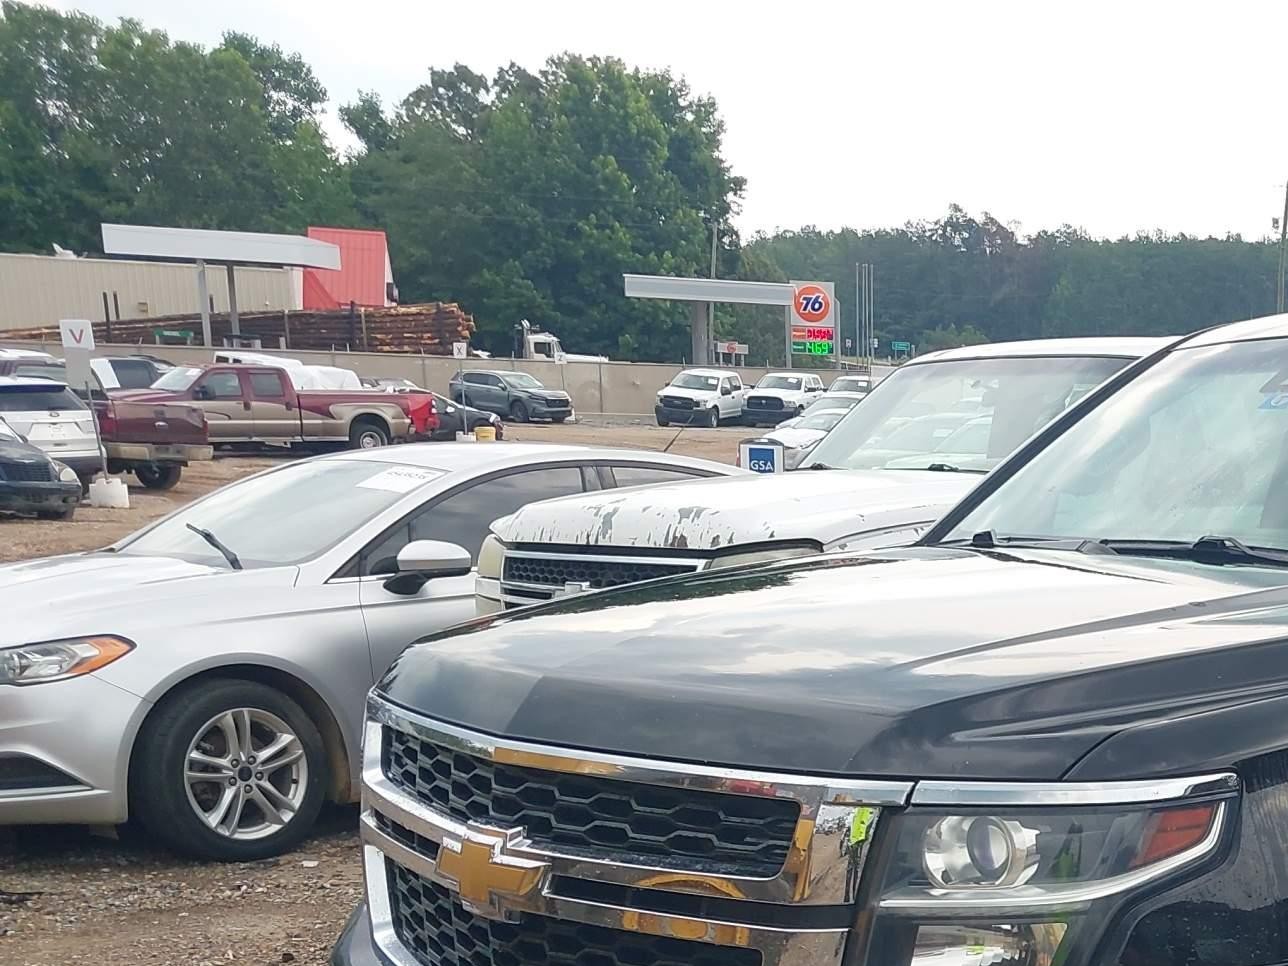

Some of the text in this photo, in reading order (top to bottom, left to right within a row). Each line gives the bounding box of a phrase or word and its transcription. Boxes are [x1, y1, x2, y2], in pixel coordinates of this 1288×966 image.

[800, 293, 825, 314] 76
[69, 328, 84, 344] V
[456, 346, 464, 356] X
[750, 459, 774, 472] GSA
